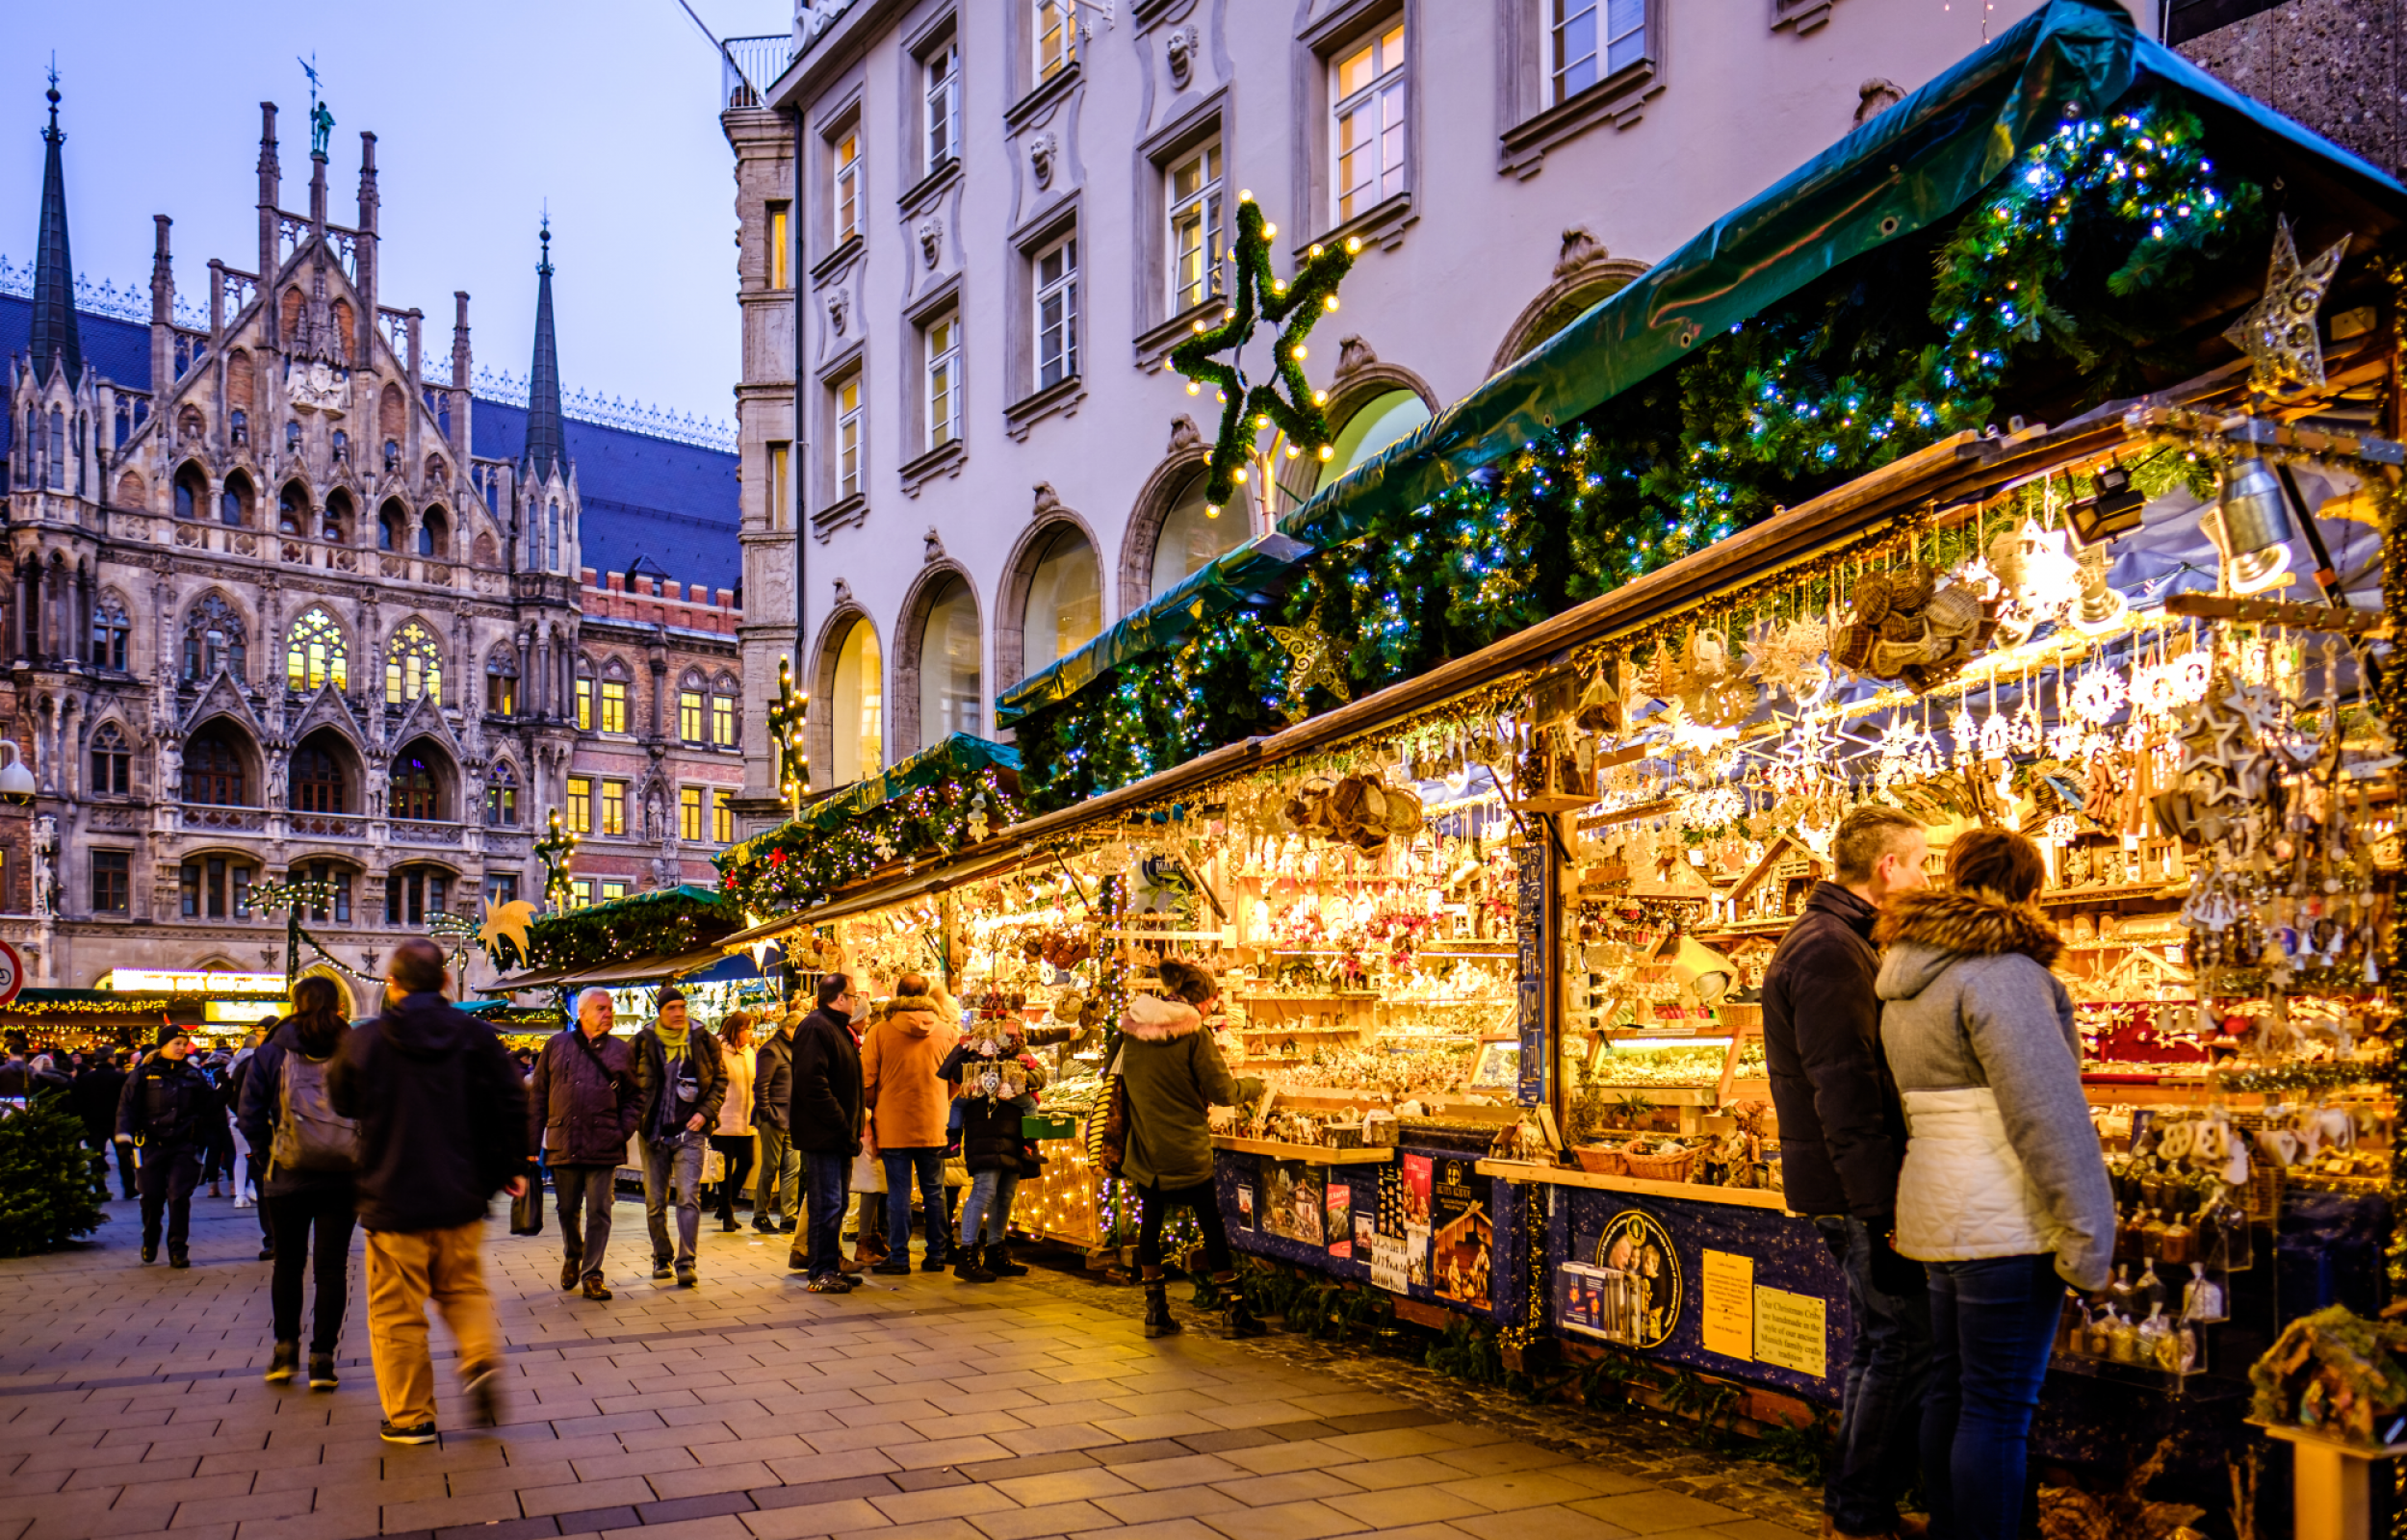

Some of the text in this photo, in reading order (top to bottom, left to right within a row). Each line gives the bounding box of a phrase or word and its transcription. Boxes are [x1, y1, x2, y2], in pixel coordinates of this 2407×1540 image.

[1761, 1299, 1822, 1320] Our Christmas Cribs
[1764, 1324, 1777, 1333] style
[1773, 1314, 1802, 1328] handmade
[1811, 1322, 1821, 1332] the
[1761, 1333, 1822, 1356] Munich family crafts
[1778, 1350, 1803, 1363] tradition
